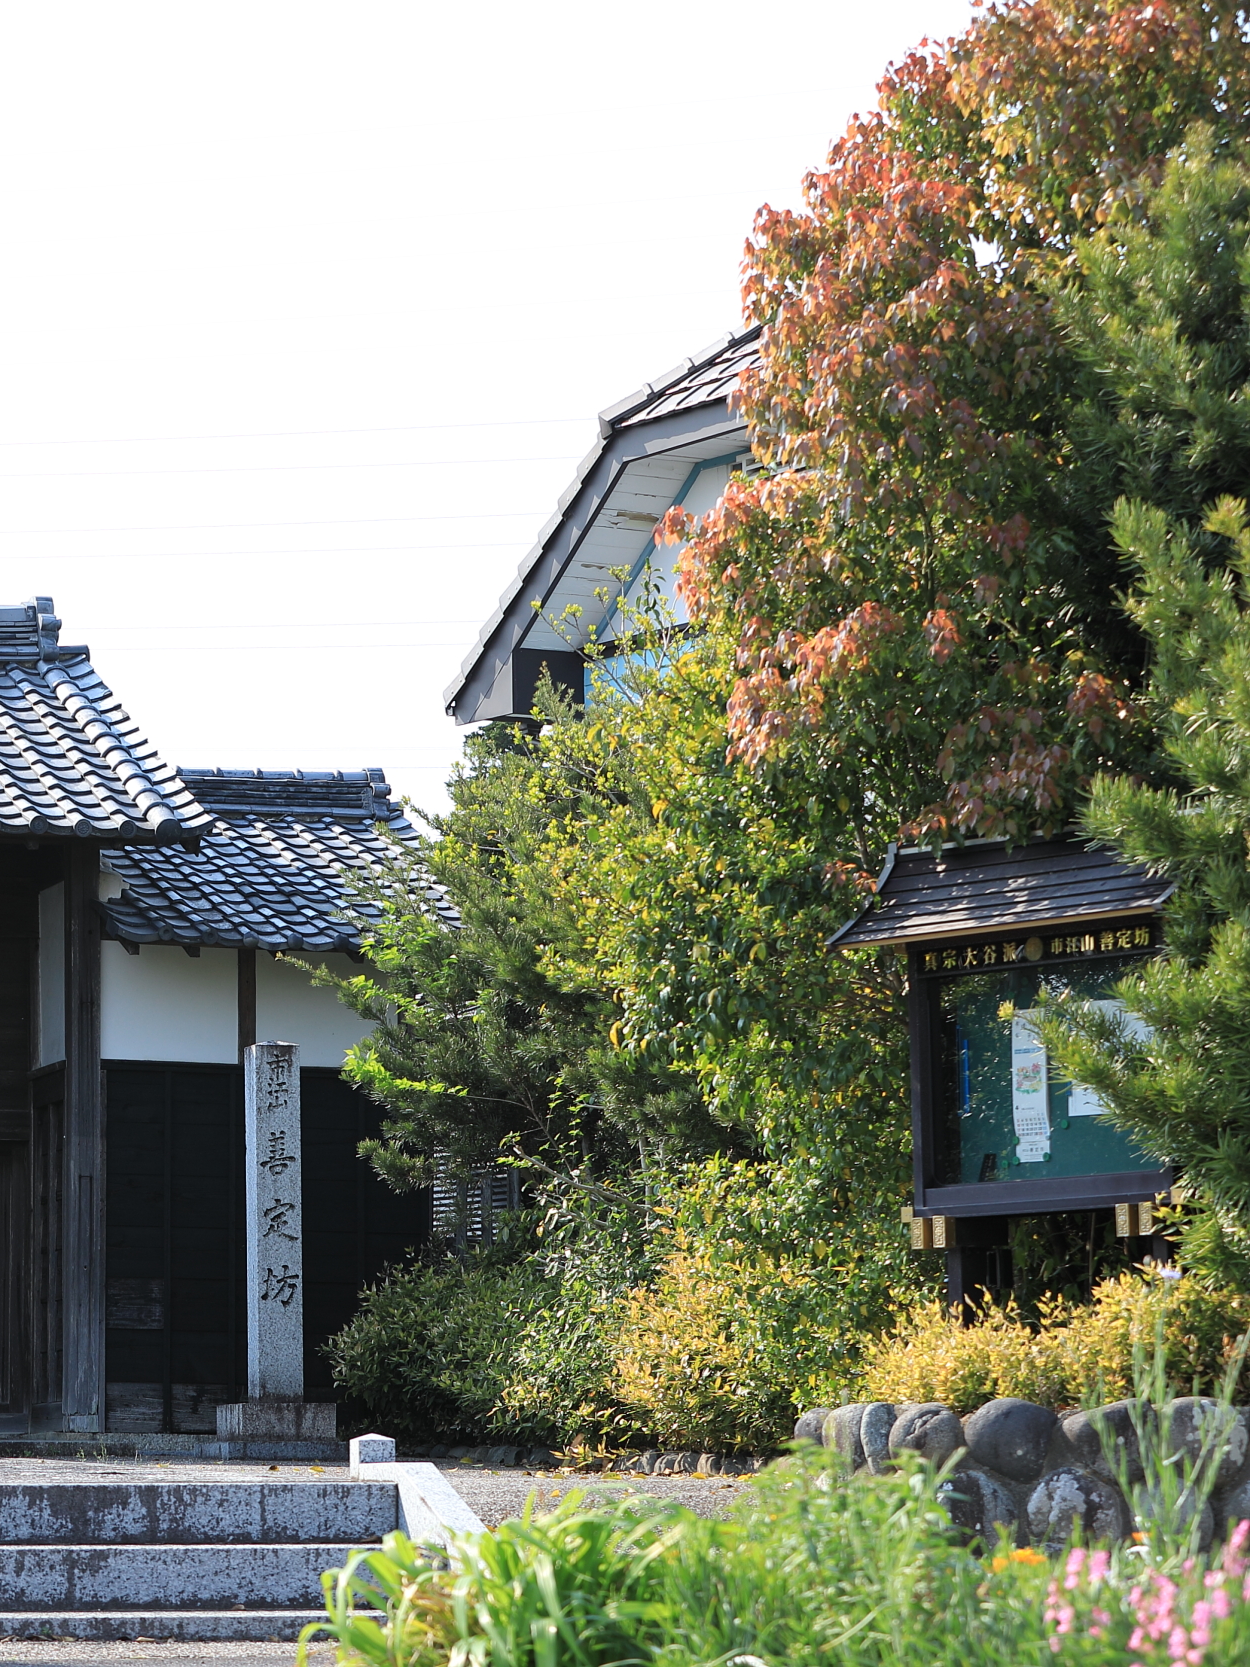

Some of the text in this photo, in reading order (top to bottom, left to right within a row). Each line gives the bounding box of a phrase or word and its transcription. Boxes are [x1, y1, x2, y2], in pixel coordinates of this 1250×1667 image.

[923, 941, 1018, 972] 真宗大谷派
